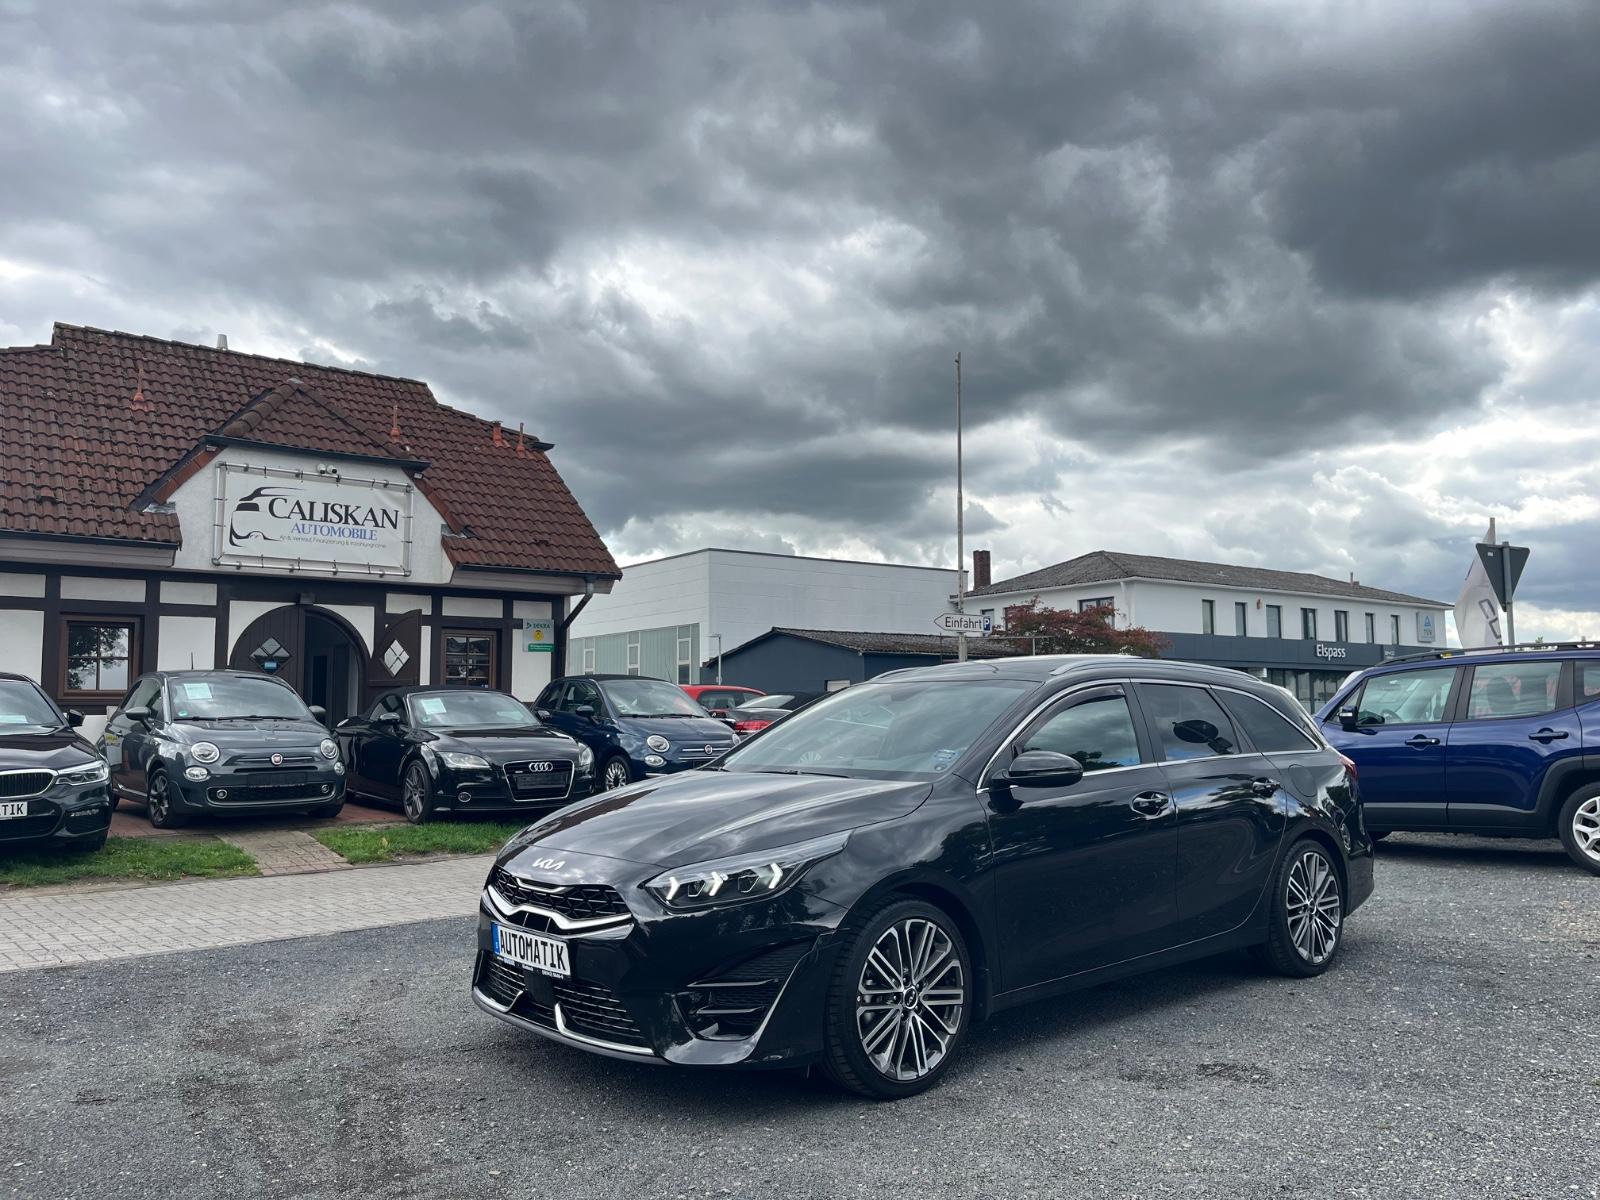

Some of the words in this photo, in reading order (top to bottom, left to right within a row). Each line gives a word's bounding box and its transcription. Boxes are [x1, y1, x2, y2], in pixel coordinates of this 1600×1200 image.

[268, 497, 400, 529] CALISKAN
[291, 522, 378, 541] AUTOMOBILE
[945, 616, 982, 629] Einfahrt
[1316, 644, 1346, 661] Elspass
[0, 803, 24, 816] TIK
[500, 929, 567, 972] AUTOMATIK
